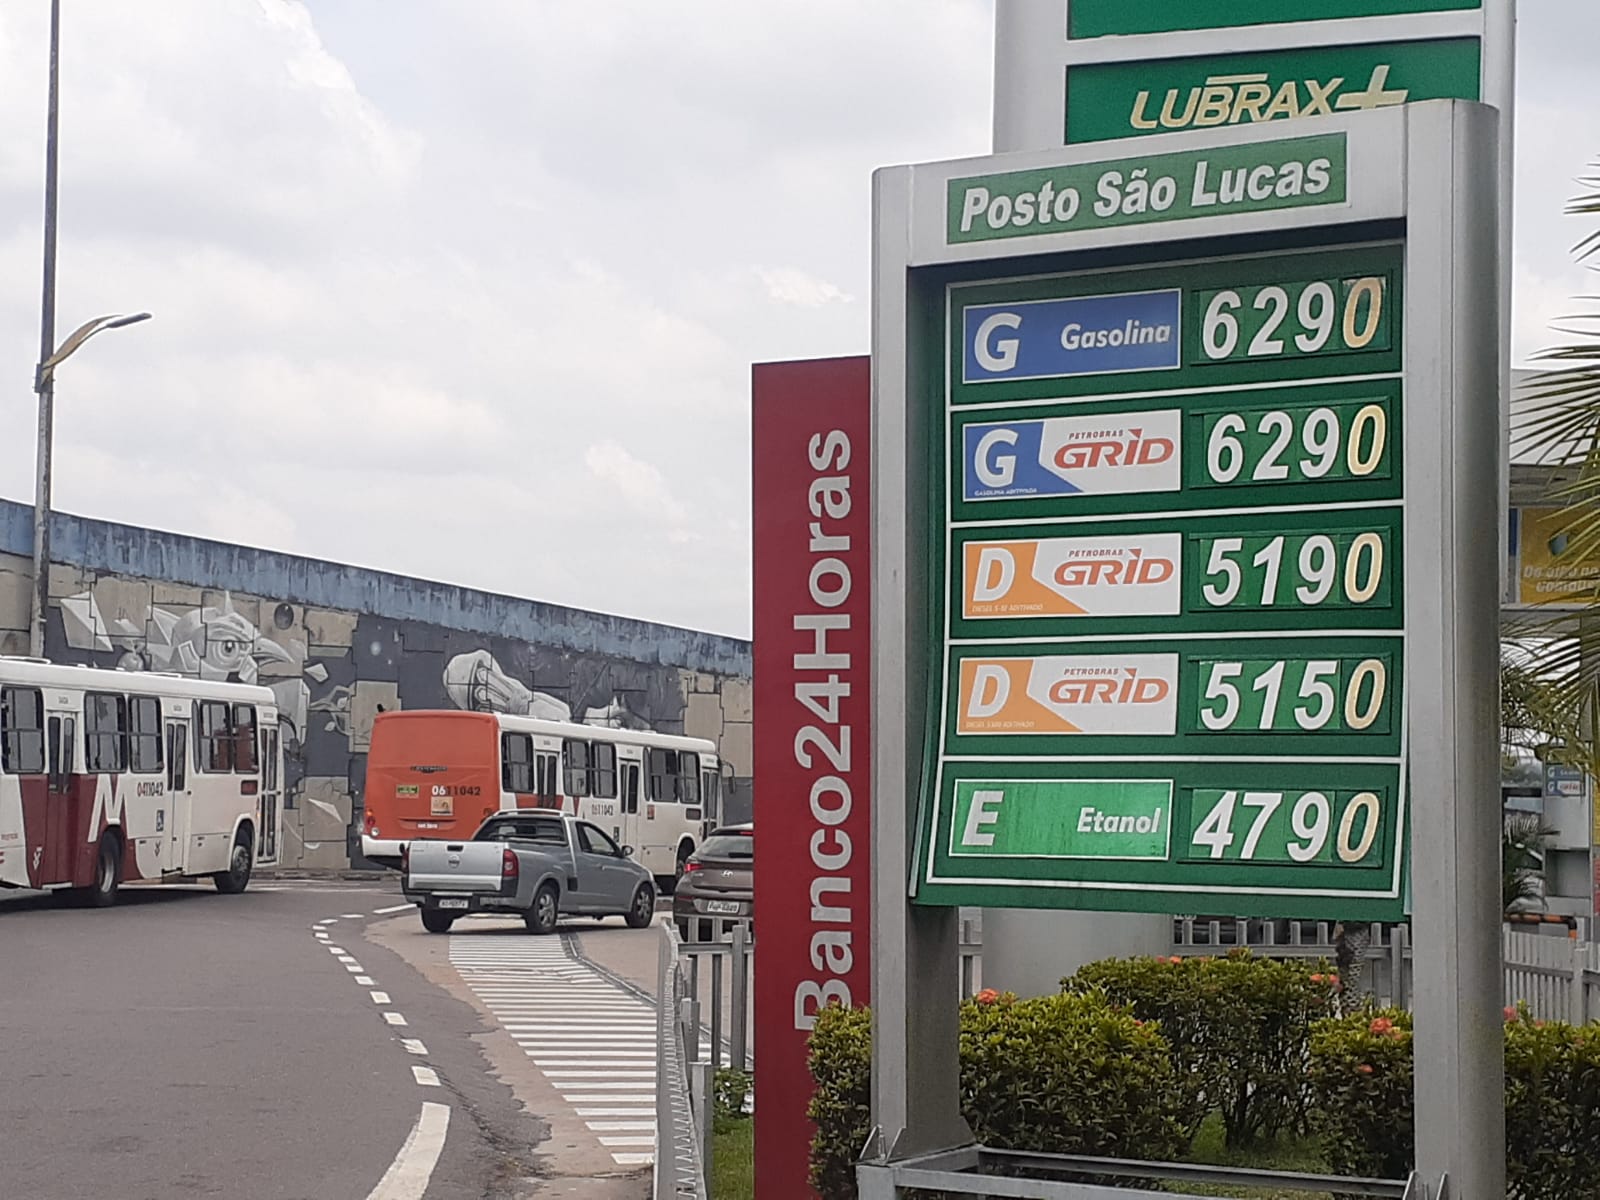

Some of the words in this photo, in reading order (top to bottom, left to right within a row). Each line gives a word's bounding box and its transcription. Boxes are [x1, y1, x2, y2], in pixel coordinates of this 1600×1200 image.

[959, 180, 1079, 233] Posto
[1093, 168, 1176, 218] São
[1189, 156, 1333, 208] Lucas
[973, 311, 1023, 373] G
[1060, 318, 1172, 351] Gasolina
[1202, 276, 1383, 360] 6290
[973, 427, 1020, 489] G
[1053, 427, 1175, 470] GRID
[1068, 428, 1124, 441] PETROBRAS
[1207, 403, 1387, 484] 6290
[972, 547, 1016, 603] D
[1053, 548, 1175, 586] GRID
[1068, 548, 1124, 558] PETROBRAS
[1202, 532, 1383, 607] 5190
[966, 663, 1011, 718] D
[1048, 667, 1170, 705] GRID
[1063, 667, 1119, 676] PETROBRAS
[1200, 658, 1386, 731] 5150
[793, 428, 852, 1030] Banco24Horas
[431, 785, 481, 797] 0611042
[961, 790, 1005, 846] E
[1076, 806, 1162, 834] Etanol
[1191, 790, 1381, 863] 4790
